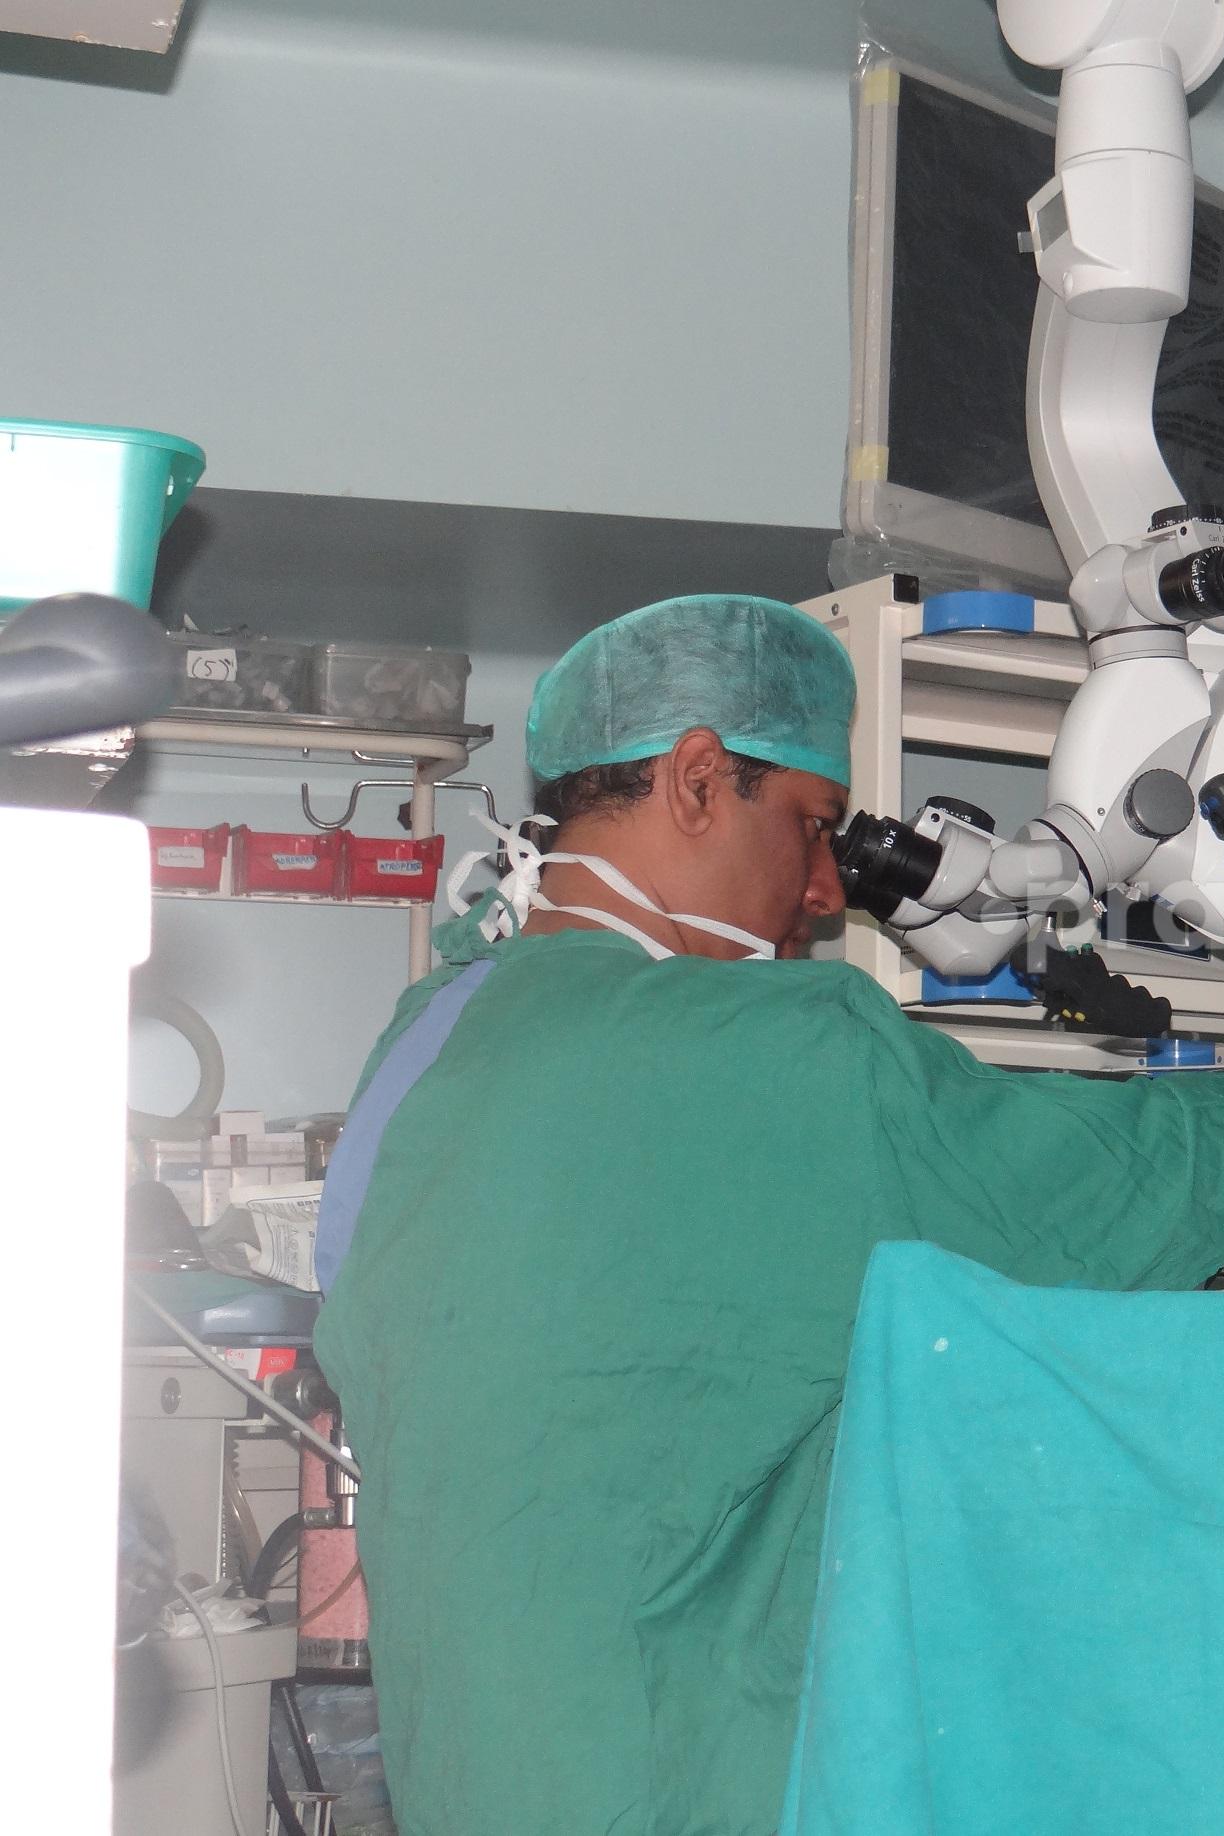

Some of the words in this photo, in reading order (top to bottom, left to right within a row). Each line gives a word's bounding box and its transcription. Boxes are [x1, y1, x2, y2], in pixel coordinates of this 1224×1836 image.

[1191, 558, 1200, 577] Carl
[1191, 577, 1205, 602] Zeiss
[883, 838, 894, 849] 10
